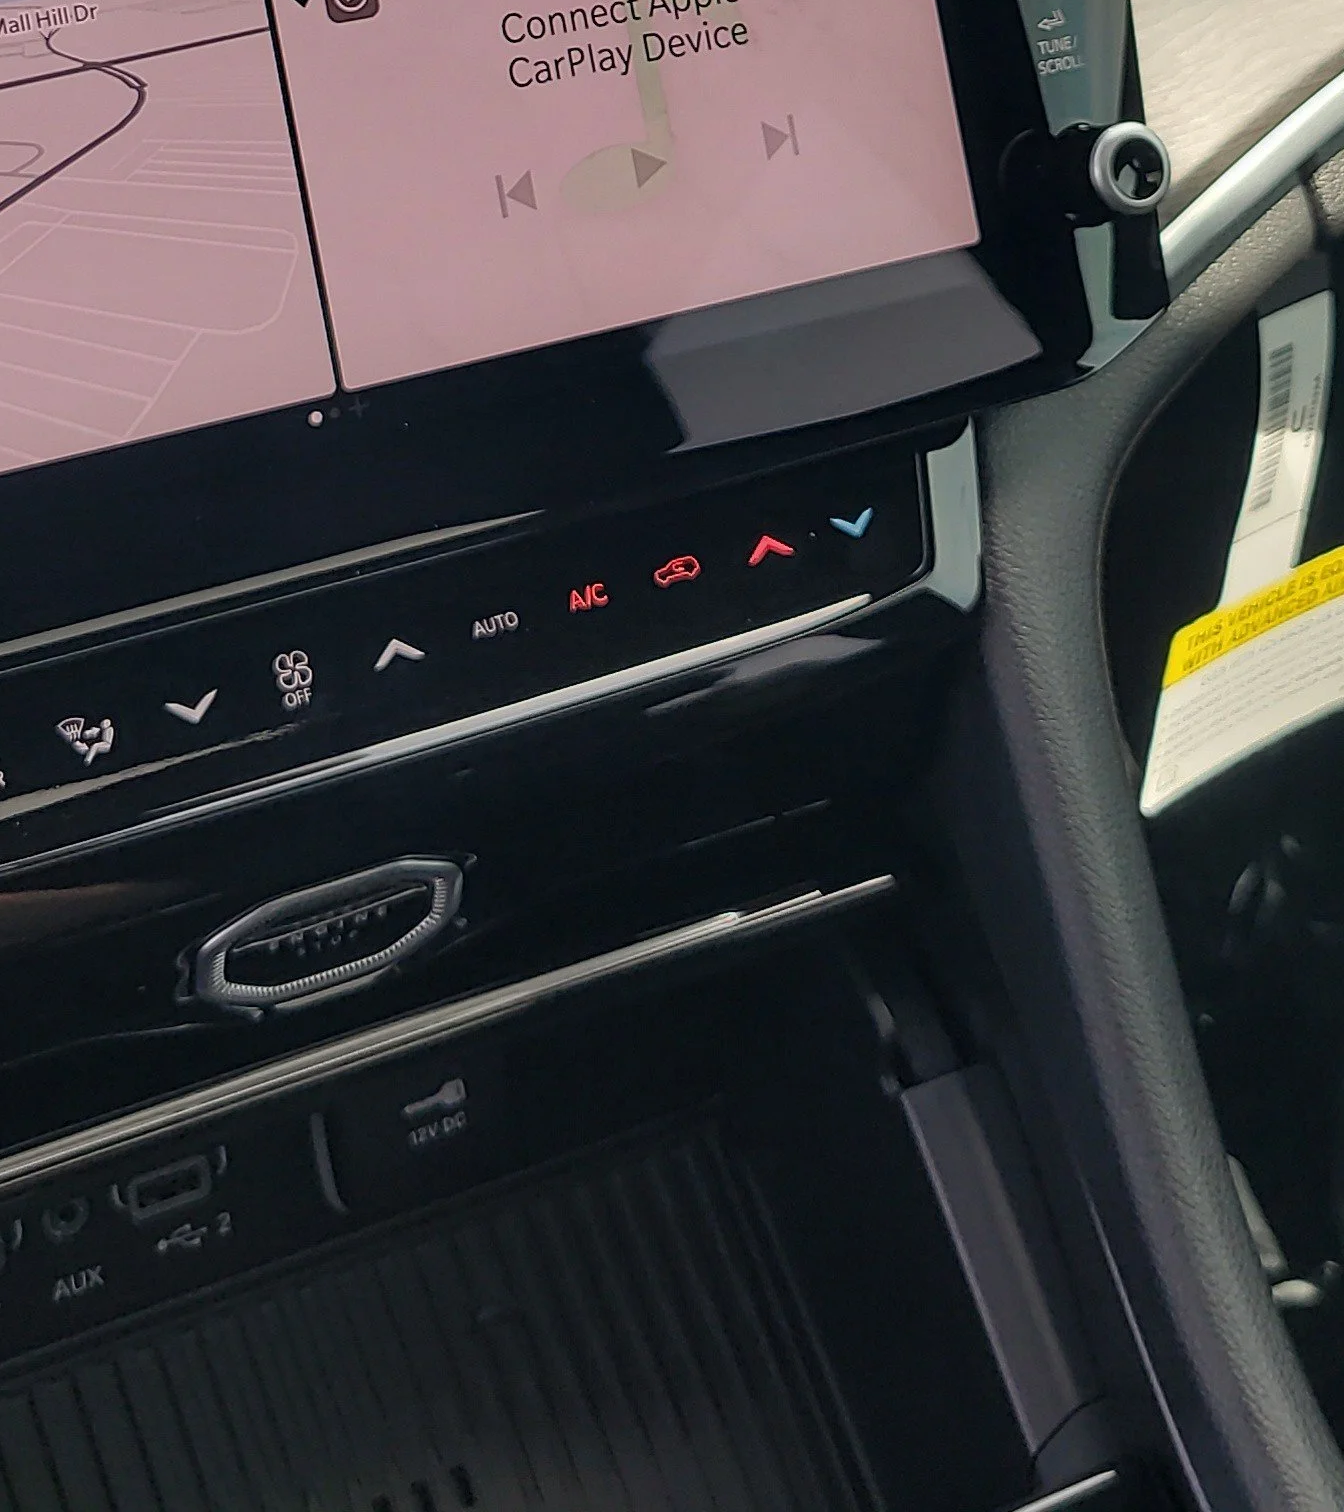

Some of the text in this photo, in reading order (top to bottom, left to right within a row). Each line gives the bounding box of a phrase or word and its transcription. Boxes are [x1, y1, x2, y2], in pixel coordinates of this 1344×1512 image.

[33, 6, 70, 32] Hill
[74, 2, 98, 23] Dr
[508, 18, 750, 89] CarPlay Device
[1037, 57, 1086, 76] SCROLL
[569, 583, 609, 613] A/C
[472, 610, 519, 640] AUTO
[1187, 619, 1222, 651] THIS
[1228, 578, 1298, 626] VEHICLE
[1182, 641, 1223, 671] WITH
[281, 689, 314, 709] OFF
[52, 1264, 105, 1302] AUX
